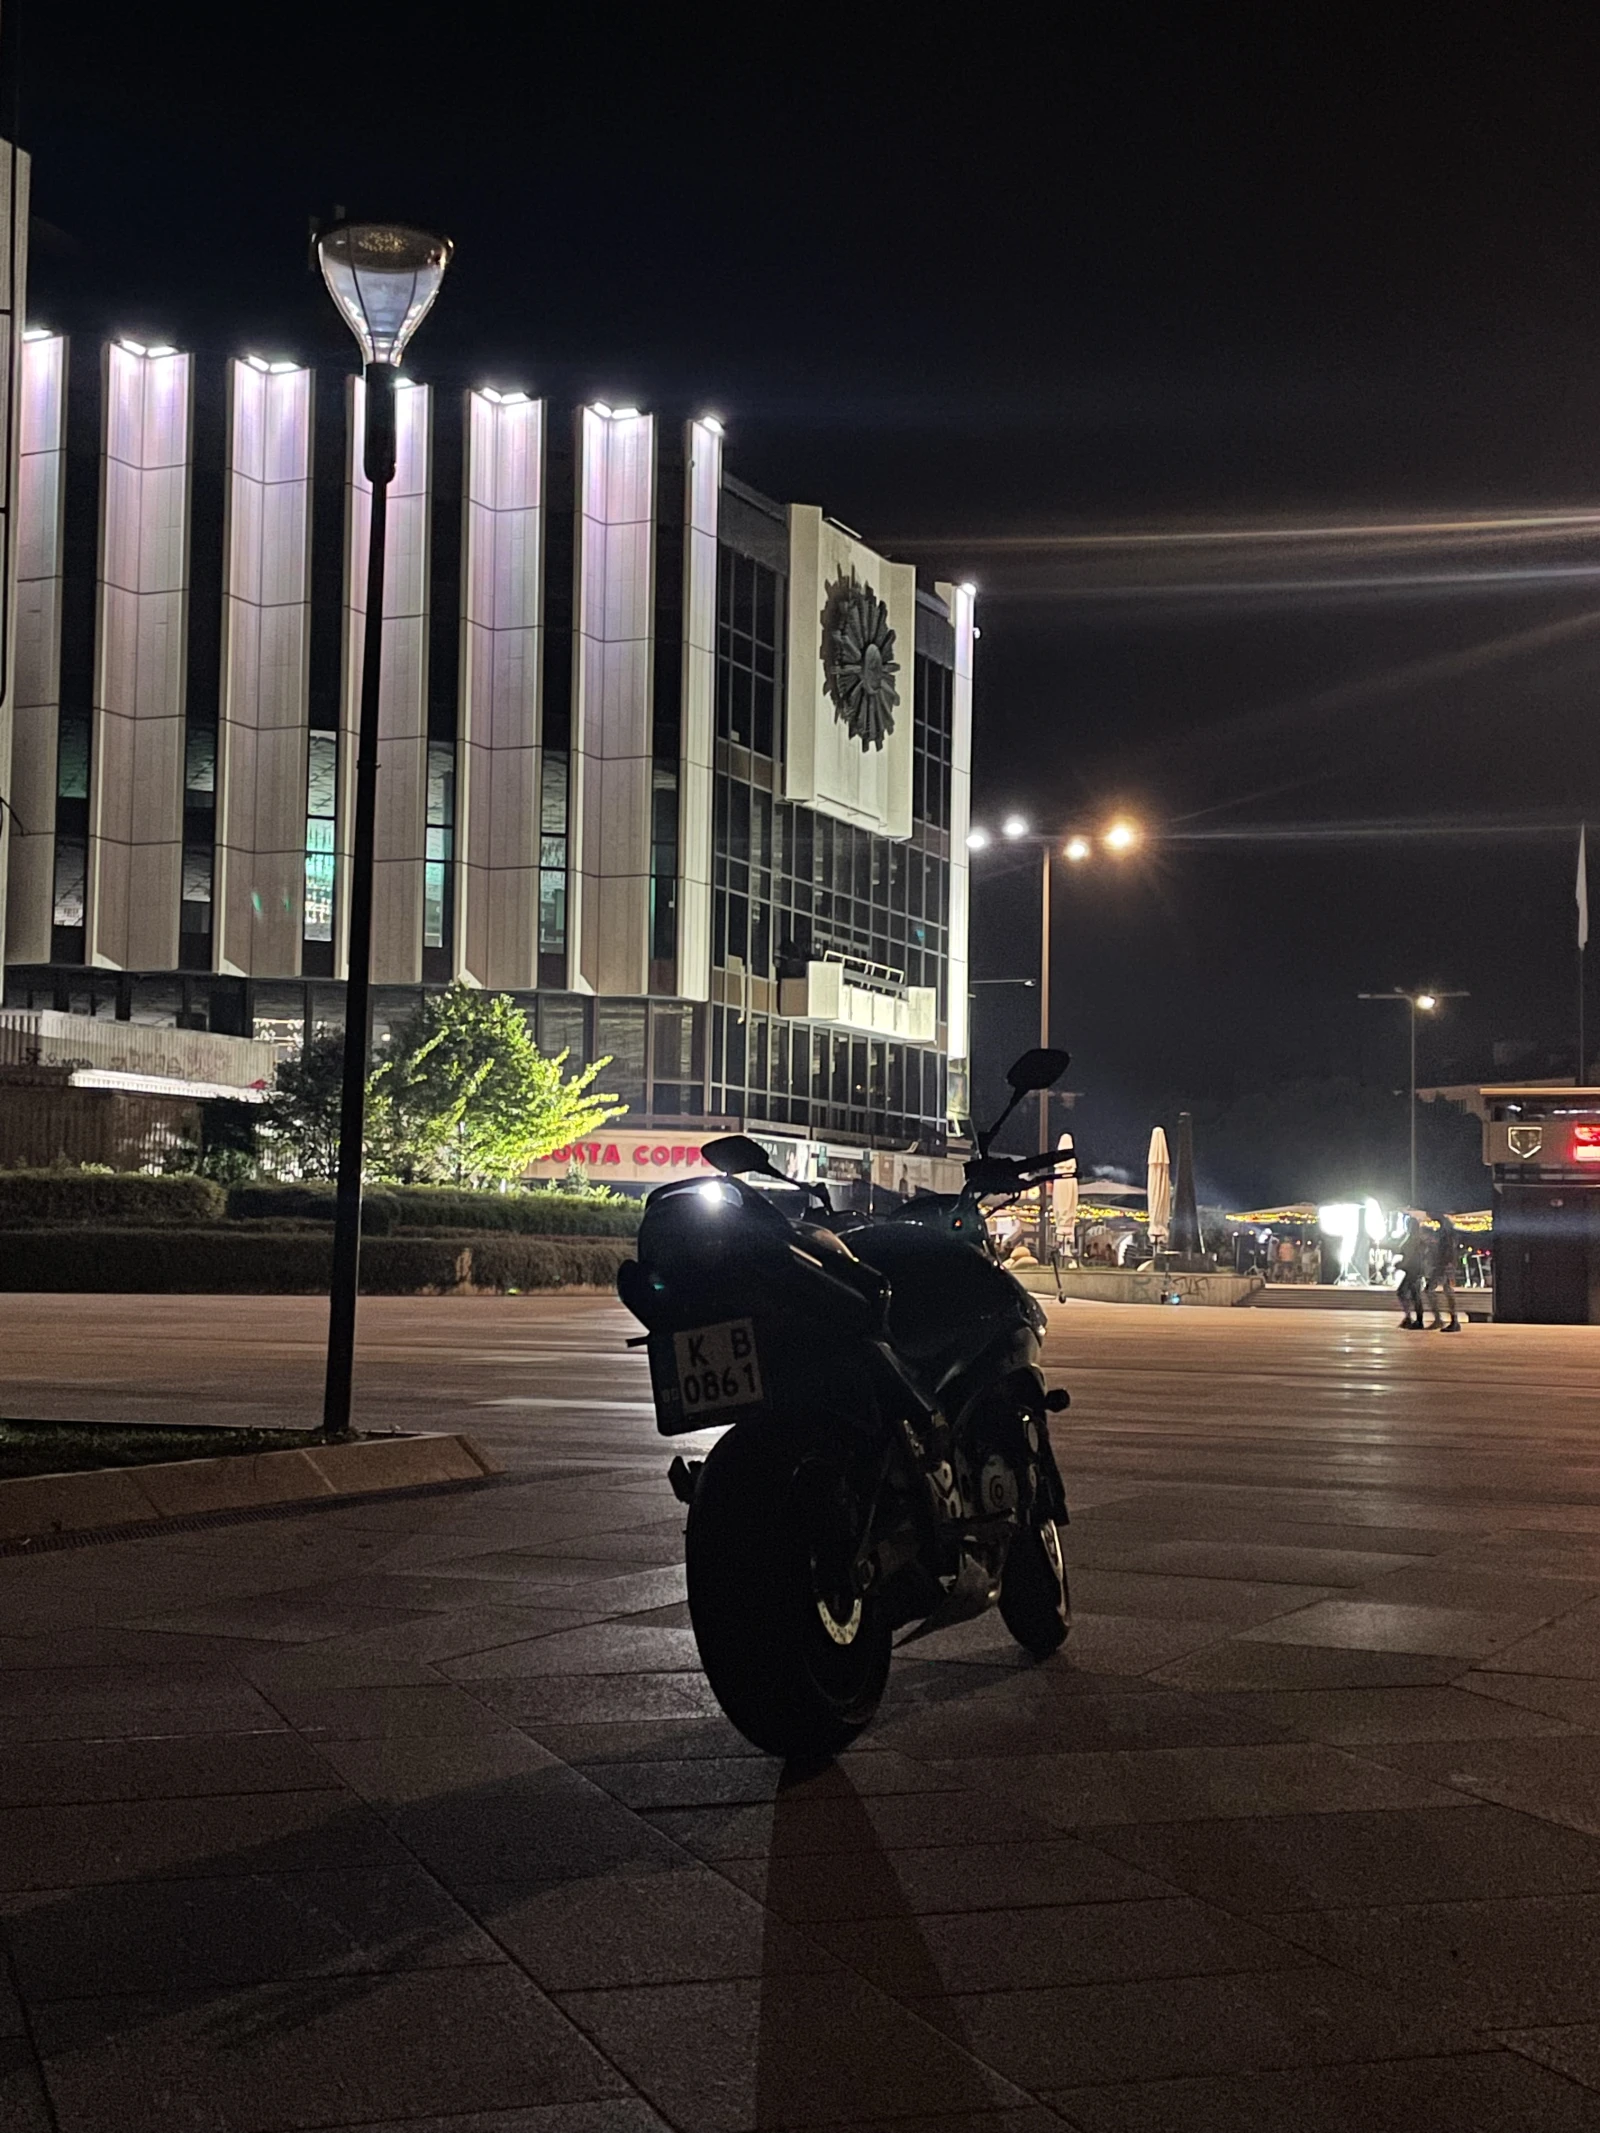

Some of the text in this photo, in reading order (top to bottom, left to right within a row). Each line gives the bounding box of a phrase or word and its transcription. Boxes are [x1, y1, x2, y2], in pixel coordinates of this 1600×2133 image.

[541, 1141, 711, 1167] OSTA COFF
[687, 1327, 752, 1367] K B
[684, 1362, 756, 1405] 0861
